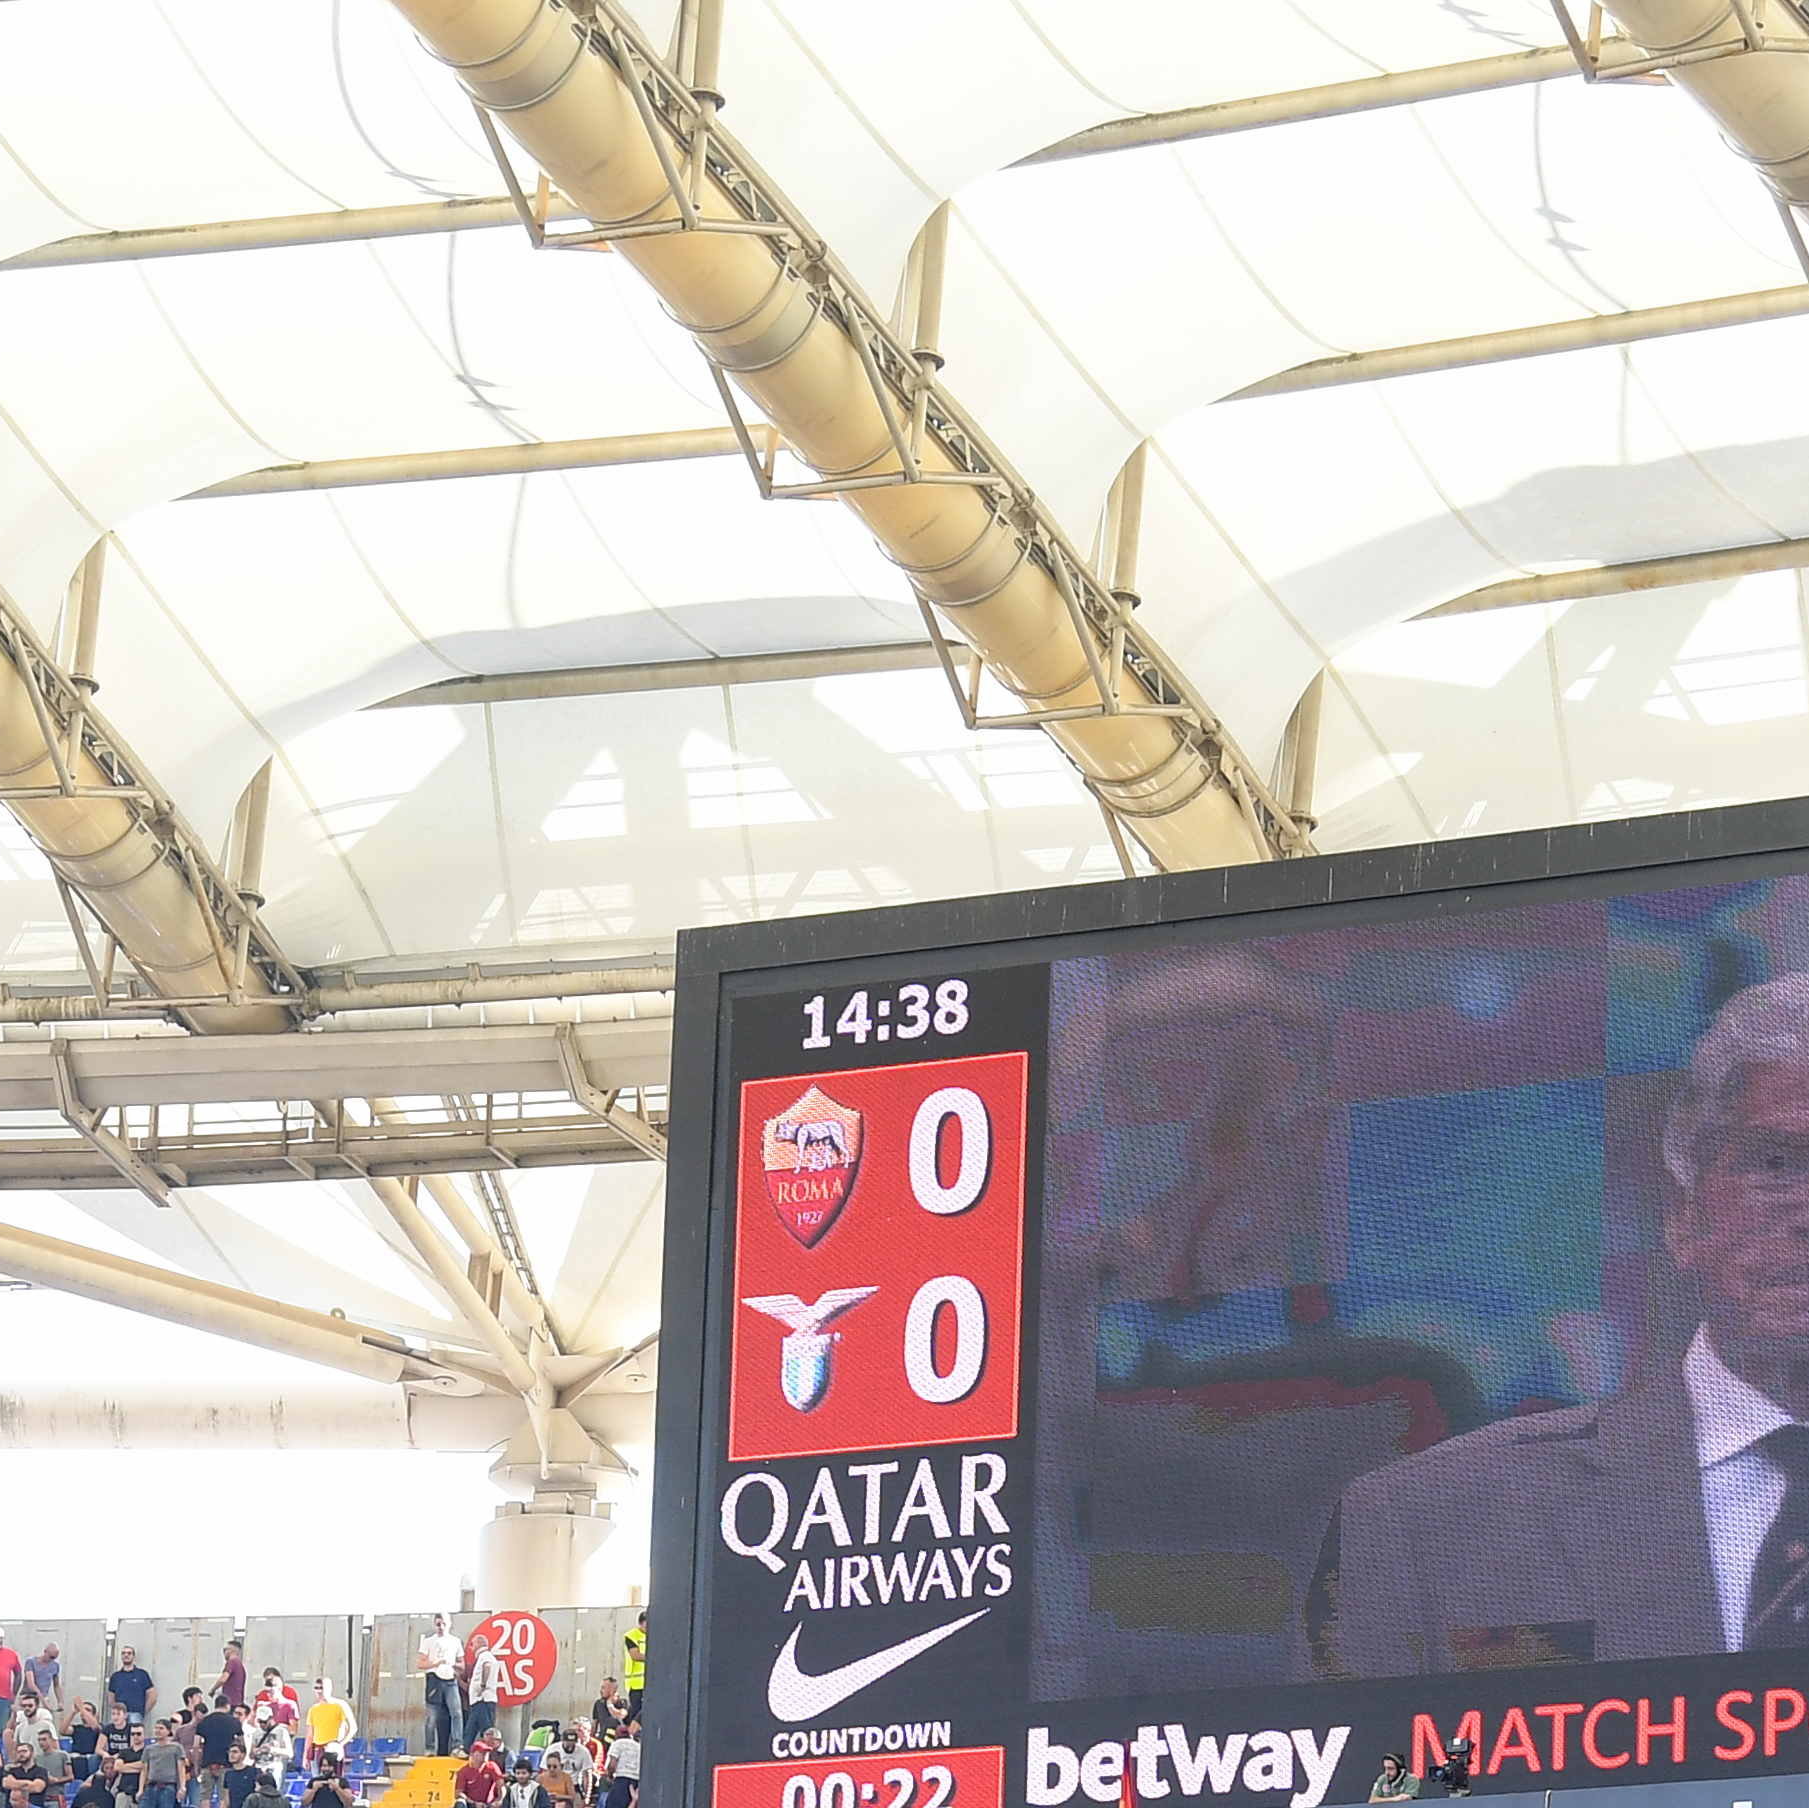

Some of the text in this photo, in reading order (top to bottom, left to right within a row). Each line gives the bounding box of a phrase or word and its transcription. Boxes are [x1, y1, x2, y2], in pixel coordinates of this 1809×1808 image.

[802, 979, 971, 1050] 14:38
[909, 1087, 991, 1215] 0
[777, 1178, 845, 1204] ROMA
[905, 1275, 986, 1403] 0
[720, 1452, 1011, 1573] QATAR
[784, 1544, 1012, 1611] AIRWAYS
[490, 1619, 536, 1656] 20
[497, 1659, 535, 1696] AS
[772, 1721, 951, 1758] COUNTDOWN
[1026, 1725, 1351, 1808] betway
[1411, 1697, 1686, 1779] MATCH
